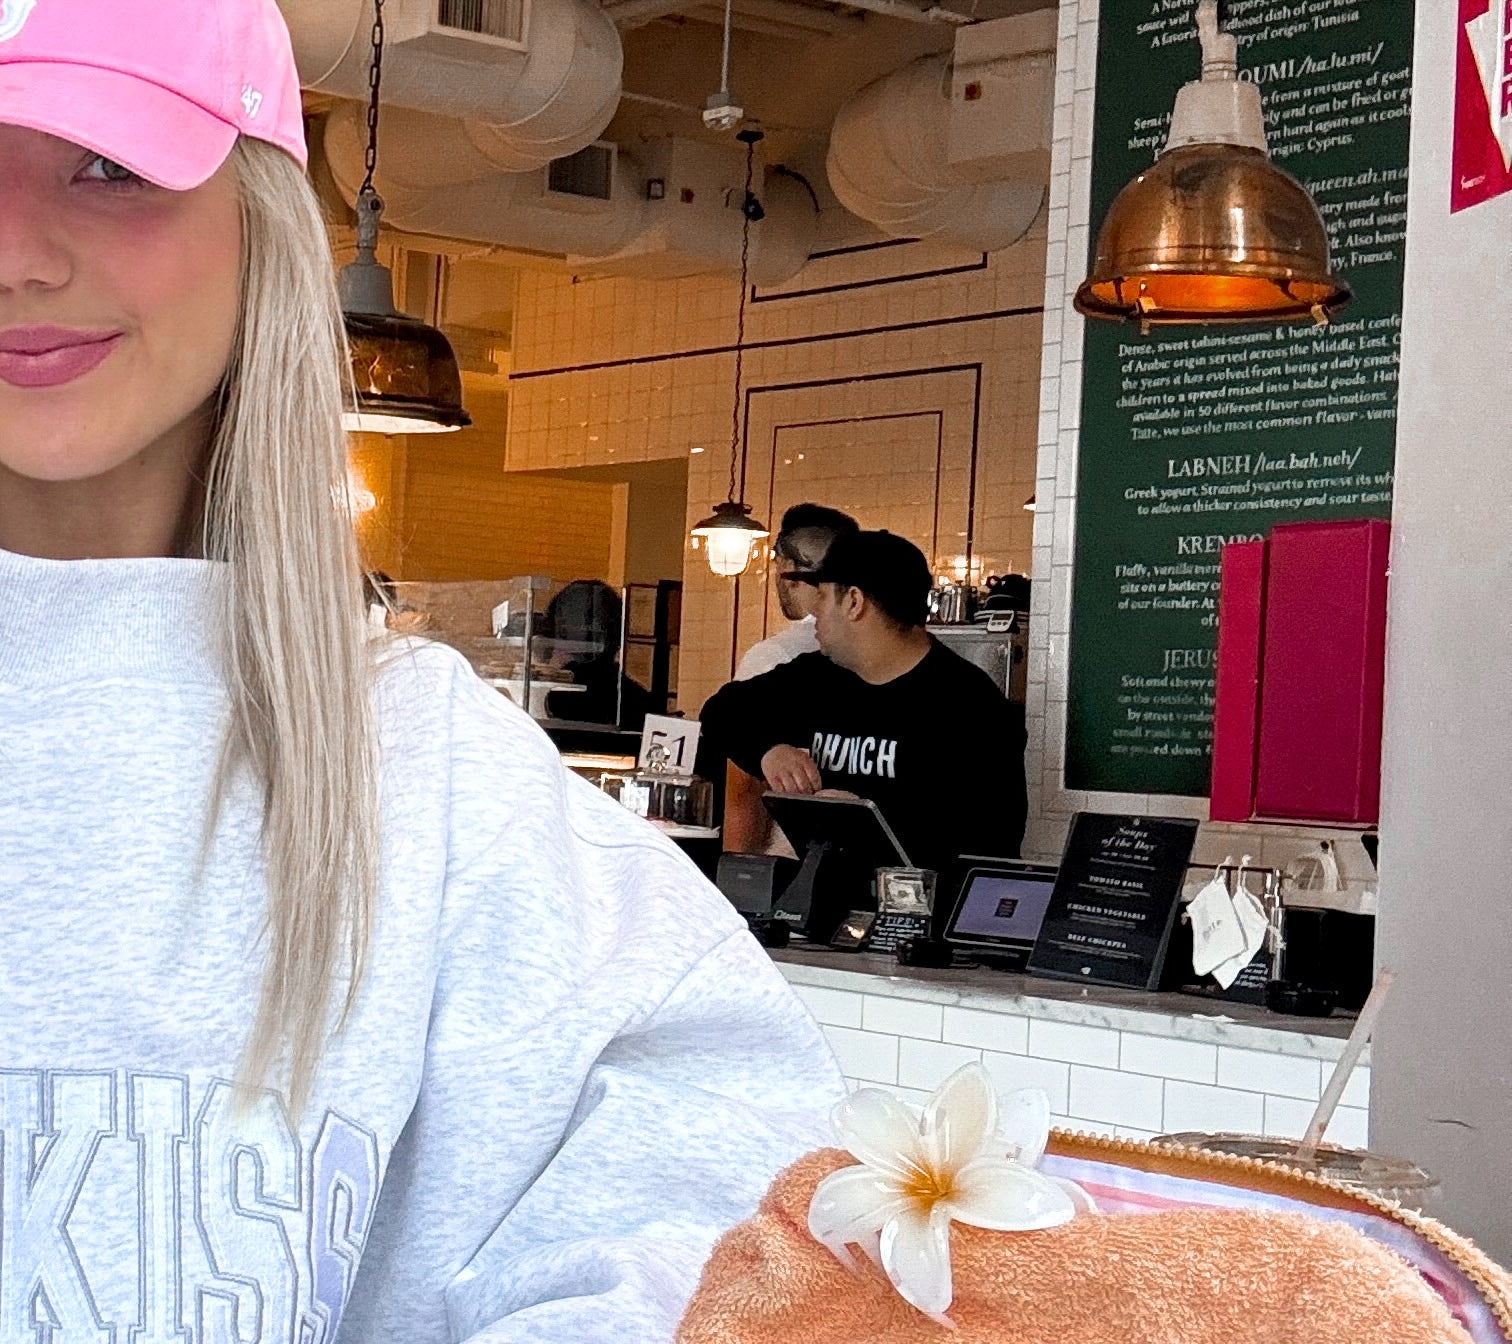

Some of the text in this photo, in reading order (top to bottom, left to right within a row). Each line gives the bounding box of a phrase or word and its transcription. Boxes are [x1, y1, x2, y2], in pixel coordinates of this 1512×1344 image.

[1311, 11, 1360, 29] Tunisia
[1271, 91, 1300, 103] from
[1282, 104, 1306, 118] and
[1283, 121, 1314, 137] hard
[1209, 350, 1247, 364] served
[1312, 338, 1354, 353] Middle
[1206, 366, 1249, 381] evolved
[1250, 364, 1282, 376] from
[1228, 382, 1264, 396] mixed
[1255, 416, 1313, 429] common
[1167, 455, 1252, 477] LABNEH
[1303, 494, 1327, 506] and
